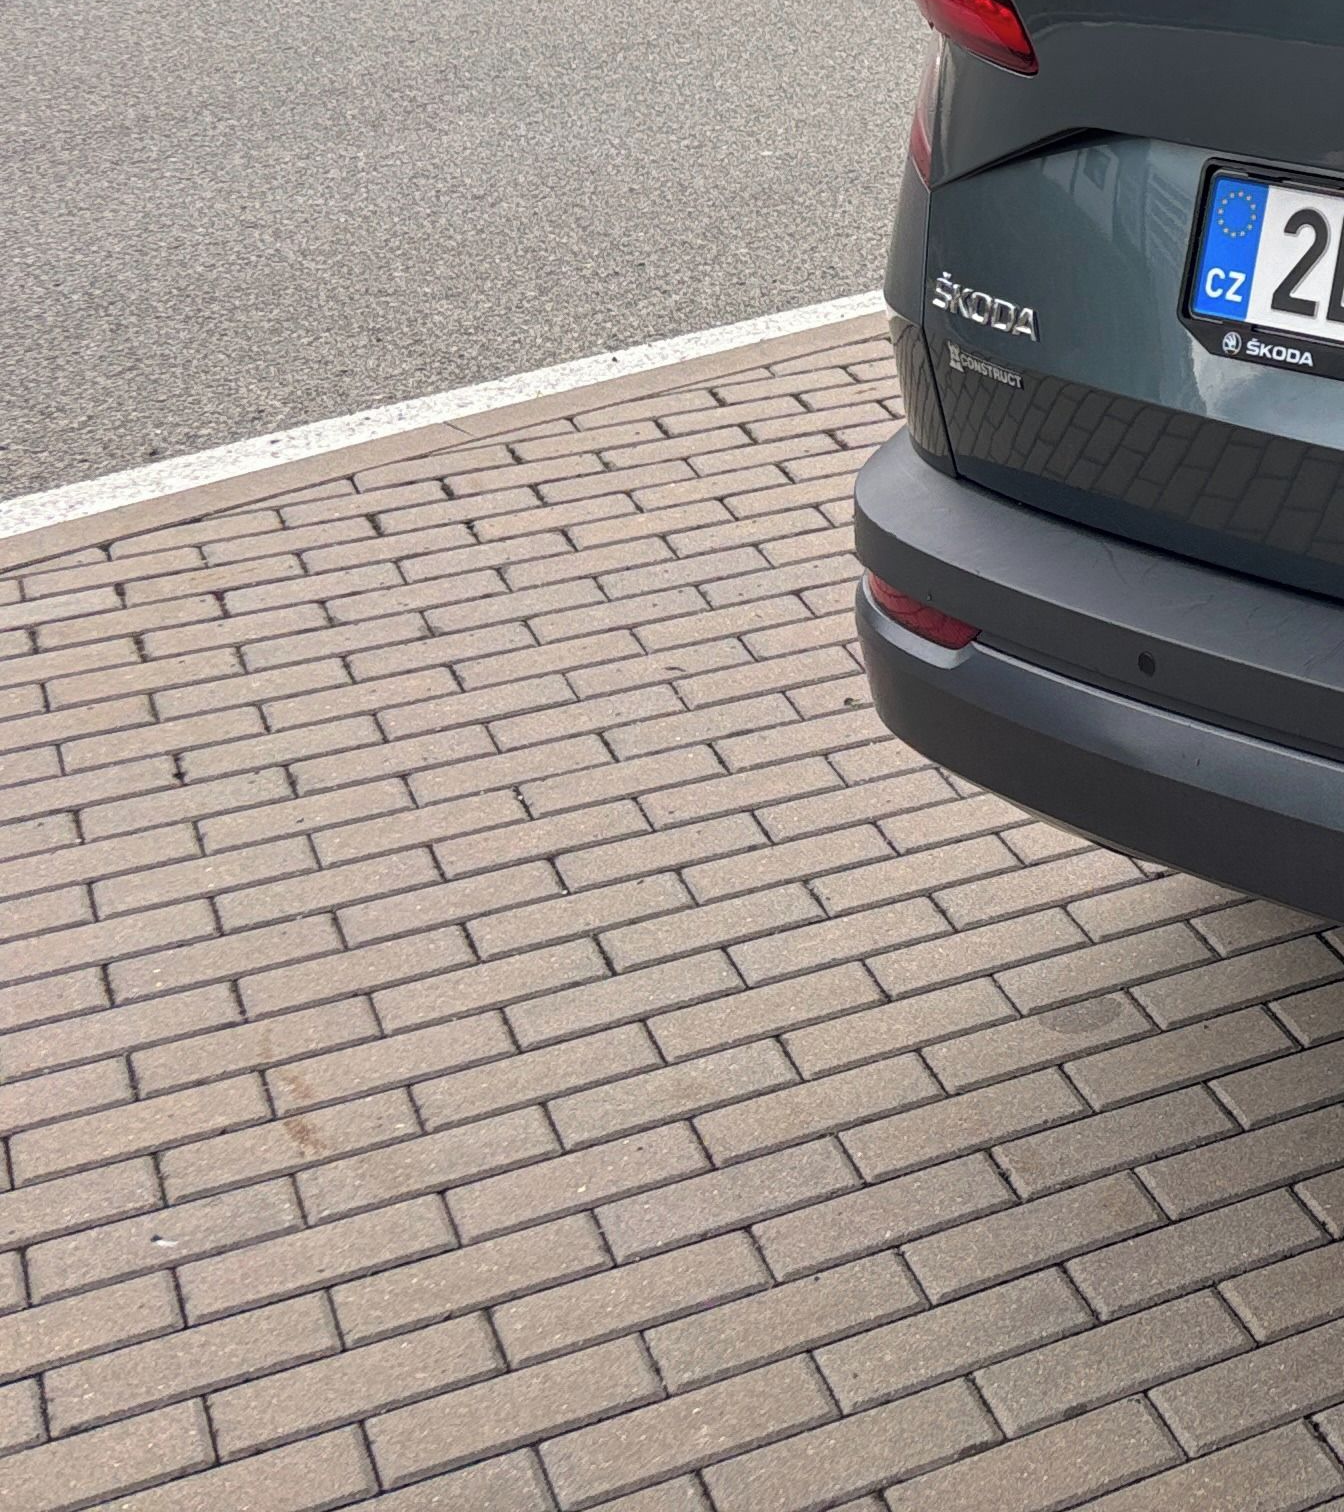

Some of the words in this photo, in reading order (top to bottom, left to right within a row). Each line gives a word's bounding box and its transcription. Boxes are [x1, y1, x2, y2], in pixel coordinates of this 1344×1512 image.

[1205, 267, 1246, 303] CZ
[932, 271, 1037, 342] ŠKODA
[1245, 338, 1314, 368] ŠKODA
[960, 354, 1022, 388] CONSTRUCT
